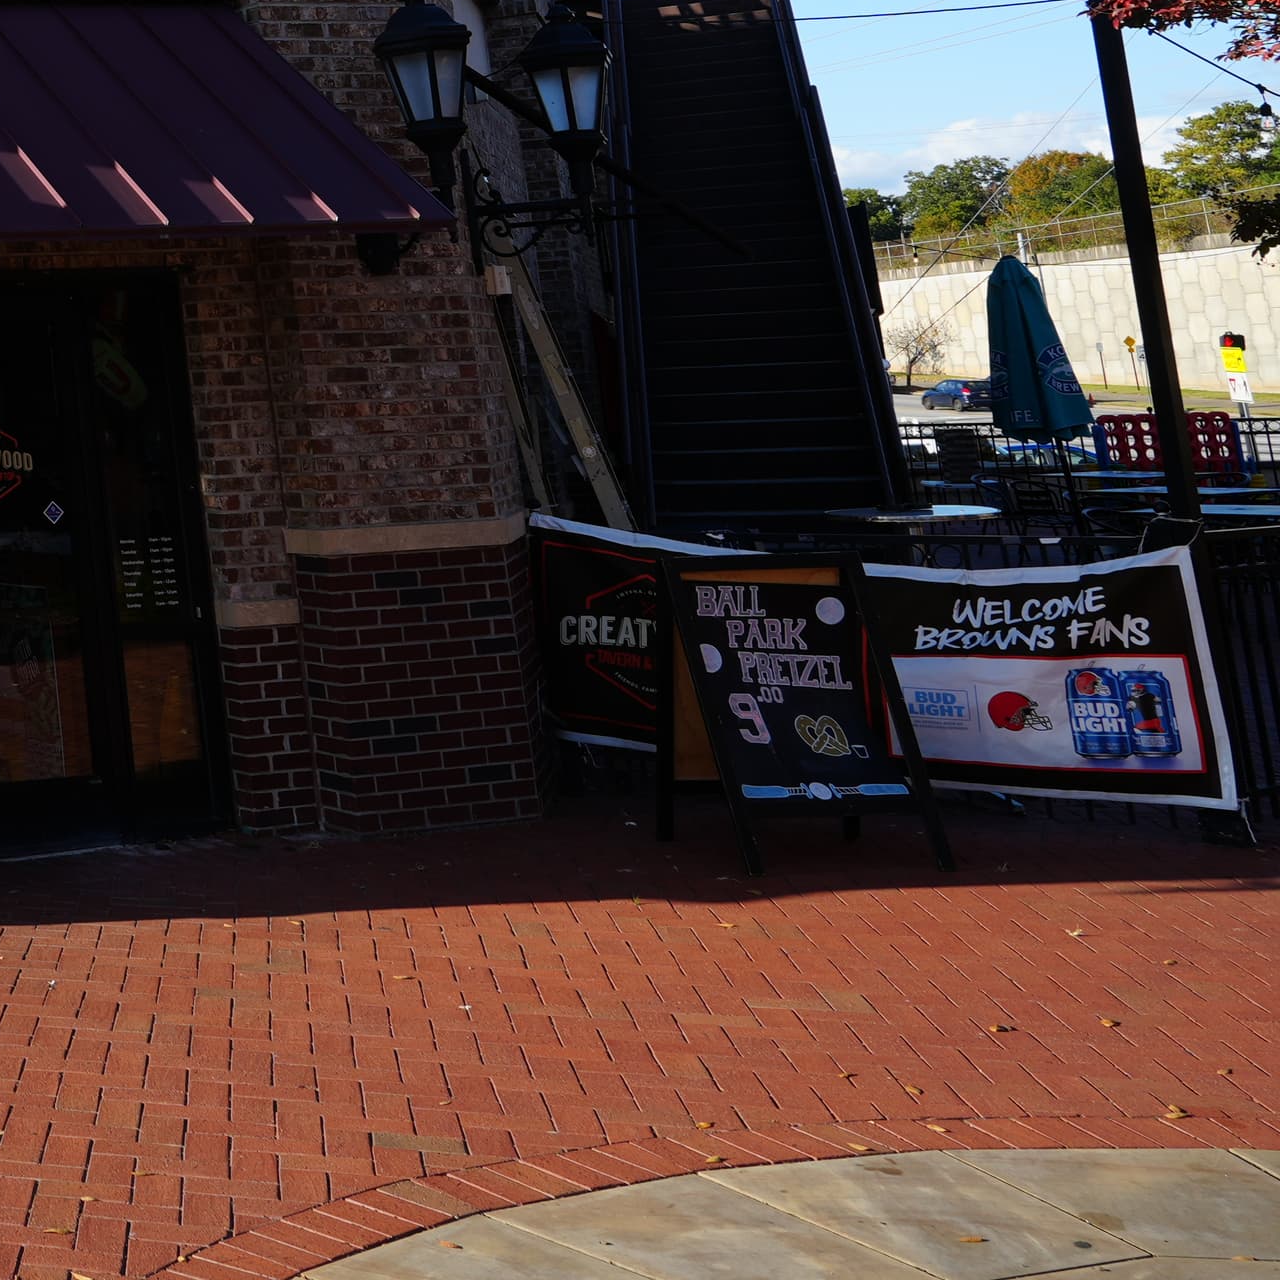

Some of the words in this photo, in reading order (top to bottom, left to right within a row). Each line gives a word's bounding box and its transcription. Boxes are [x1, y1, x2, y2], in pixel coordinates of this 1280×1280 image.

[695, 585, 767, 617] BALL
[951, 585, 1107, 629] WELCOME
[560, 615, 656, 648] CREAT
[726, 618, 809, 650] PARK
[913, 624, 1056, 652] BROWNS
[1066, 613, 1152, 650] FANS
[597, 648, 641, 670] TAVERN
[737, 651, 853, 690] PRETZEL
[908, 703, 966, 718] LIGHT
[914, 690, 957, 705] BUD
[1073, 702, 1121, 718] BUD
[1072, 717, 1128, 733] LIGHT
